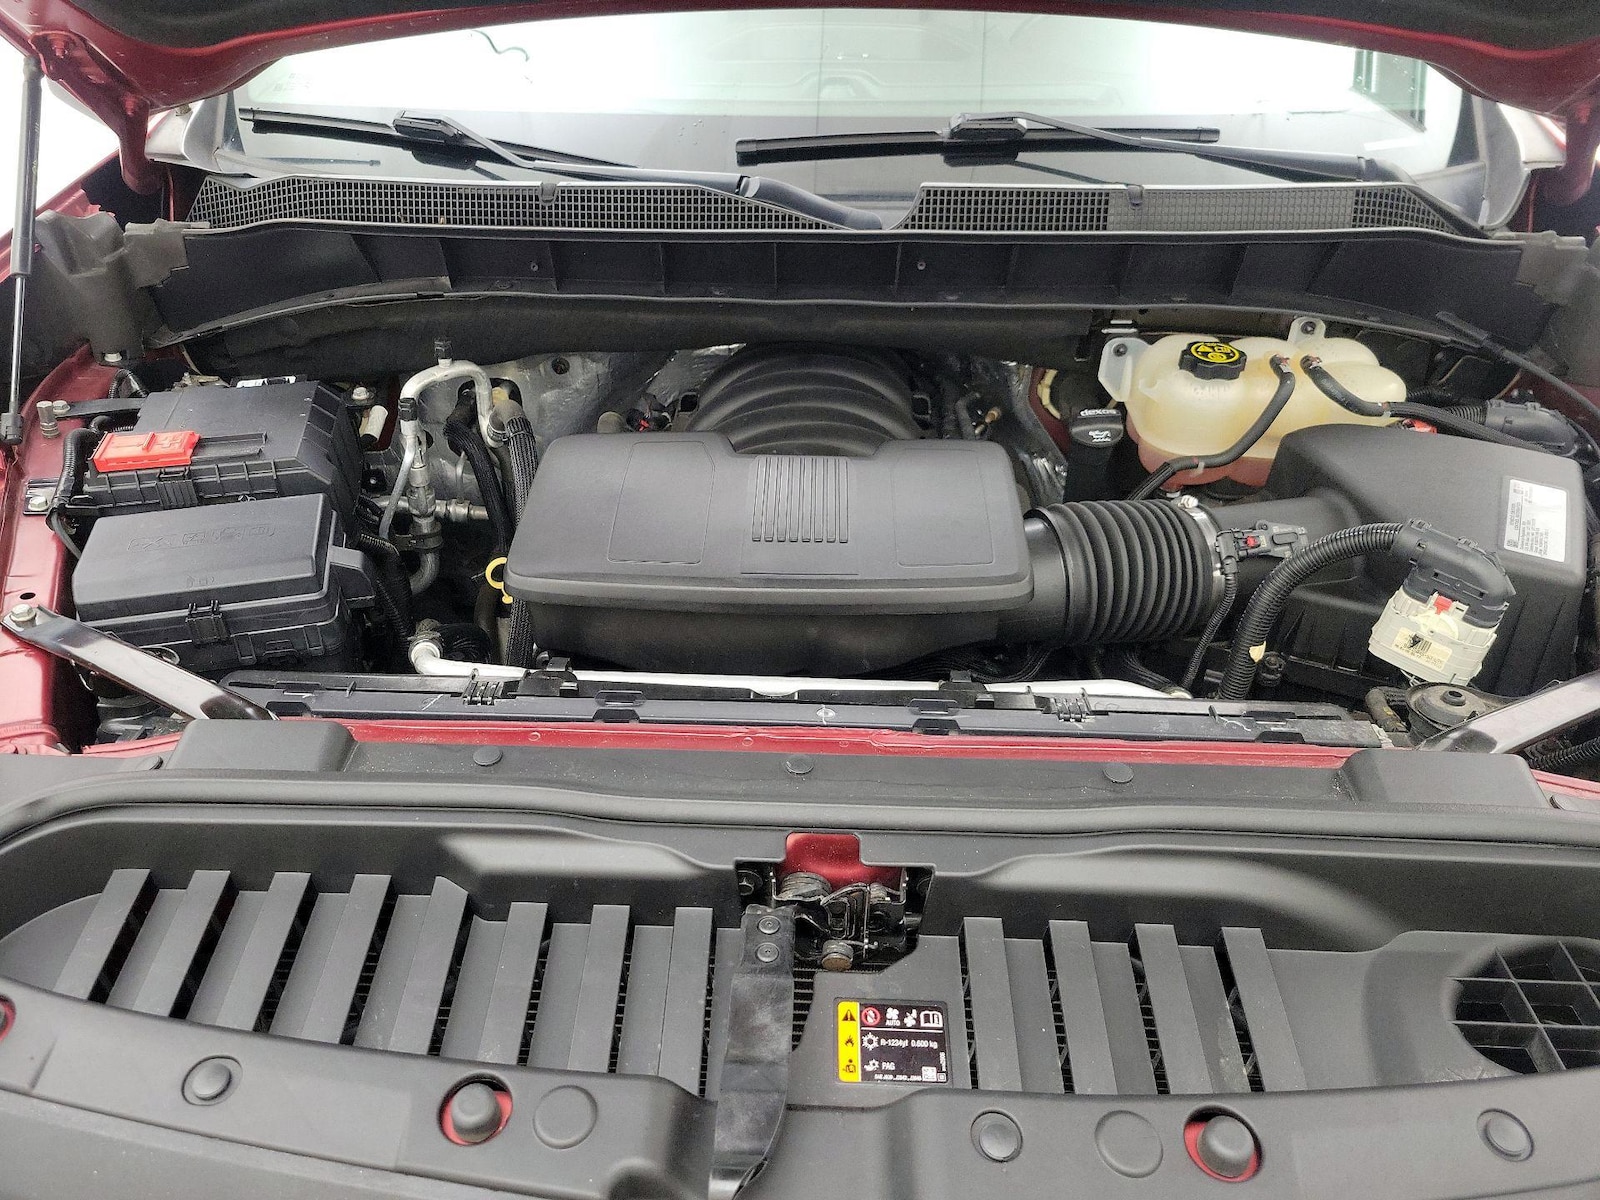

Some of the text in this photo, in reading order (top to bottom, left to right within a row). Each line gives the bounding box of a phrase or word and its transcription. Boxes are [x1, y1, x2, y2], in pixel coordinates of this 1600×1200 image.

[1080, 408, 1117, 417] dexos
[885, 1019, 901, 1027] AUTO
[929, 1040, 938, 1050] kg
[881, 1061, 896, 1071] PAG
